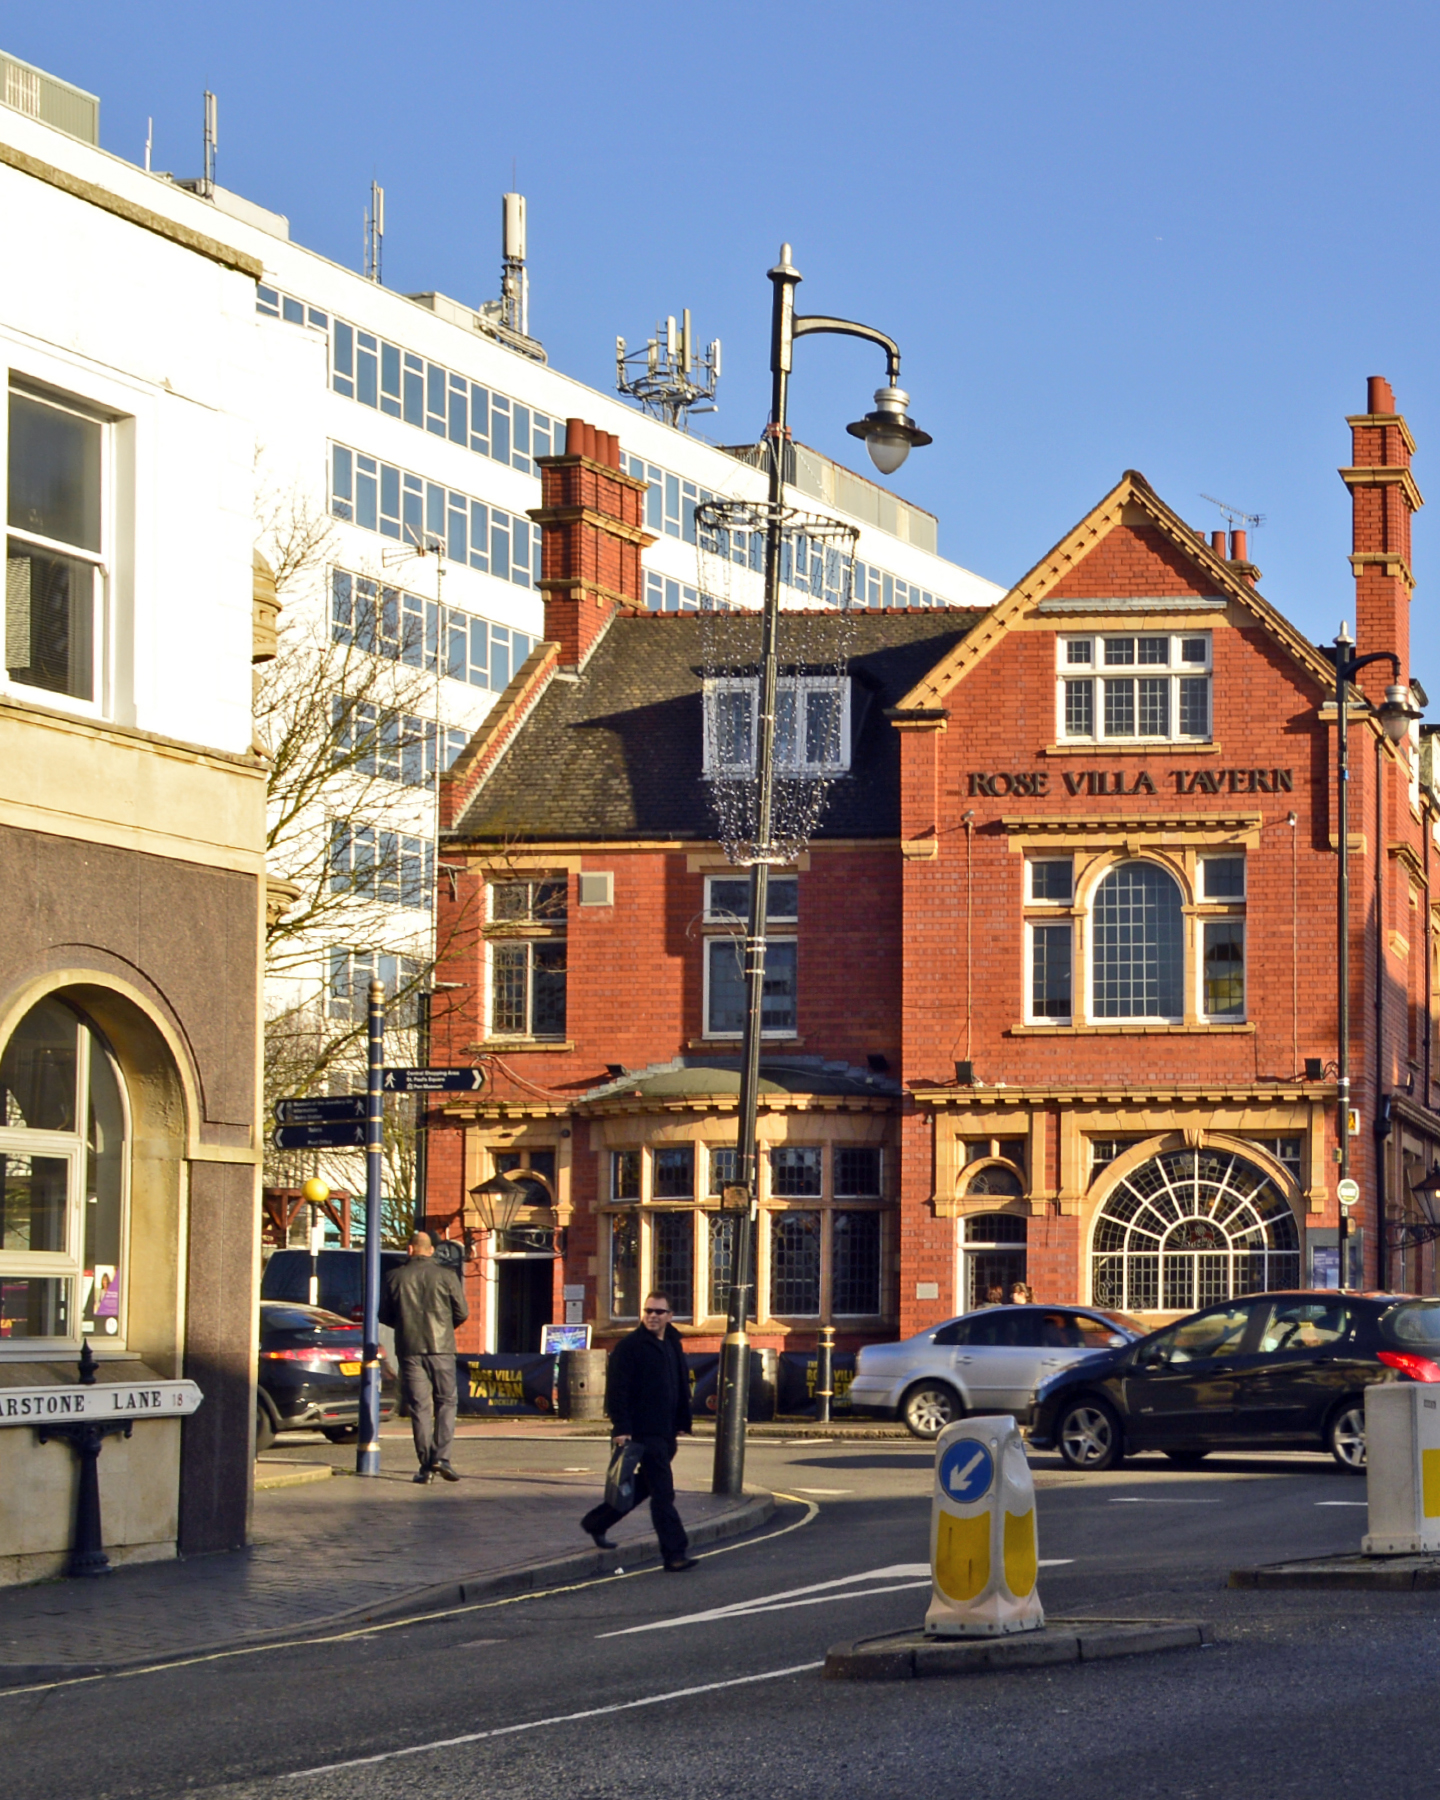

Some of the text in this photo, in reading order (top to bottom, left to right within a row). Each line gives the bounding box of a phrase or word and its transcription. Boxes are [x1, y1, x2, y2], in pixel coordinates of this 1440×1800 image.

[967, 768, 1293, 797] ROSE VILLA TAVERN
[495, 1369, 523, 1381] VILLA
[468, 1380, 525, 1398] TAVERN
[112, 1391, 162, 1411] LANE
